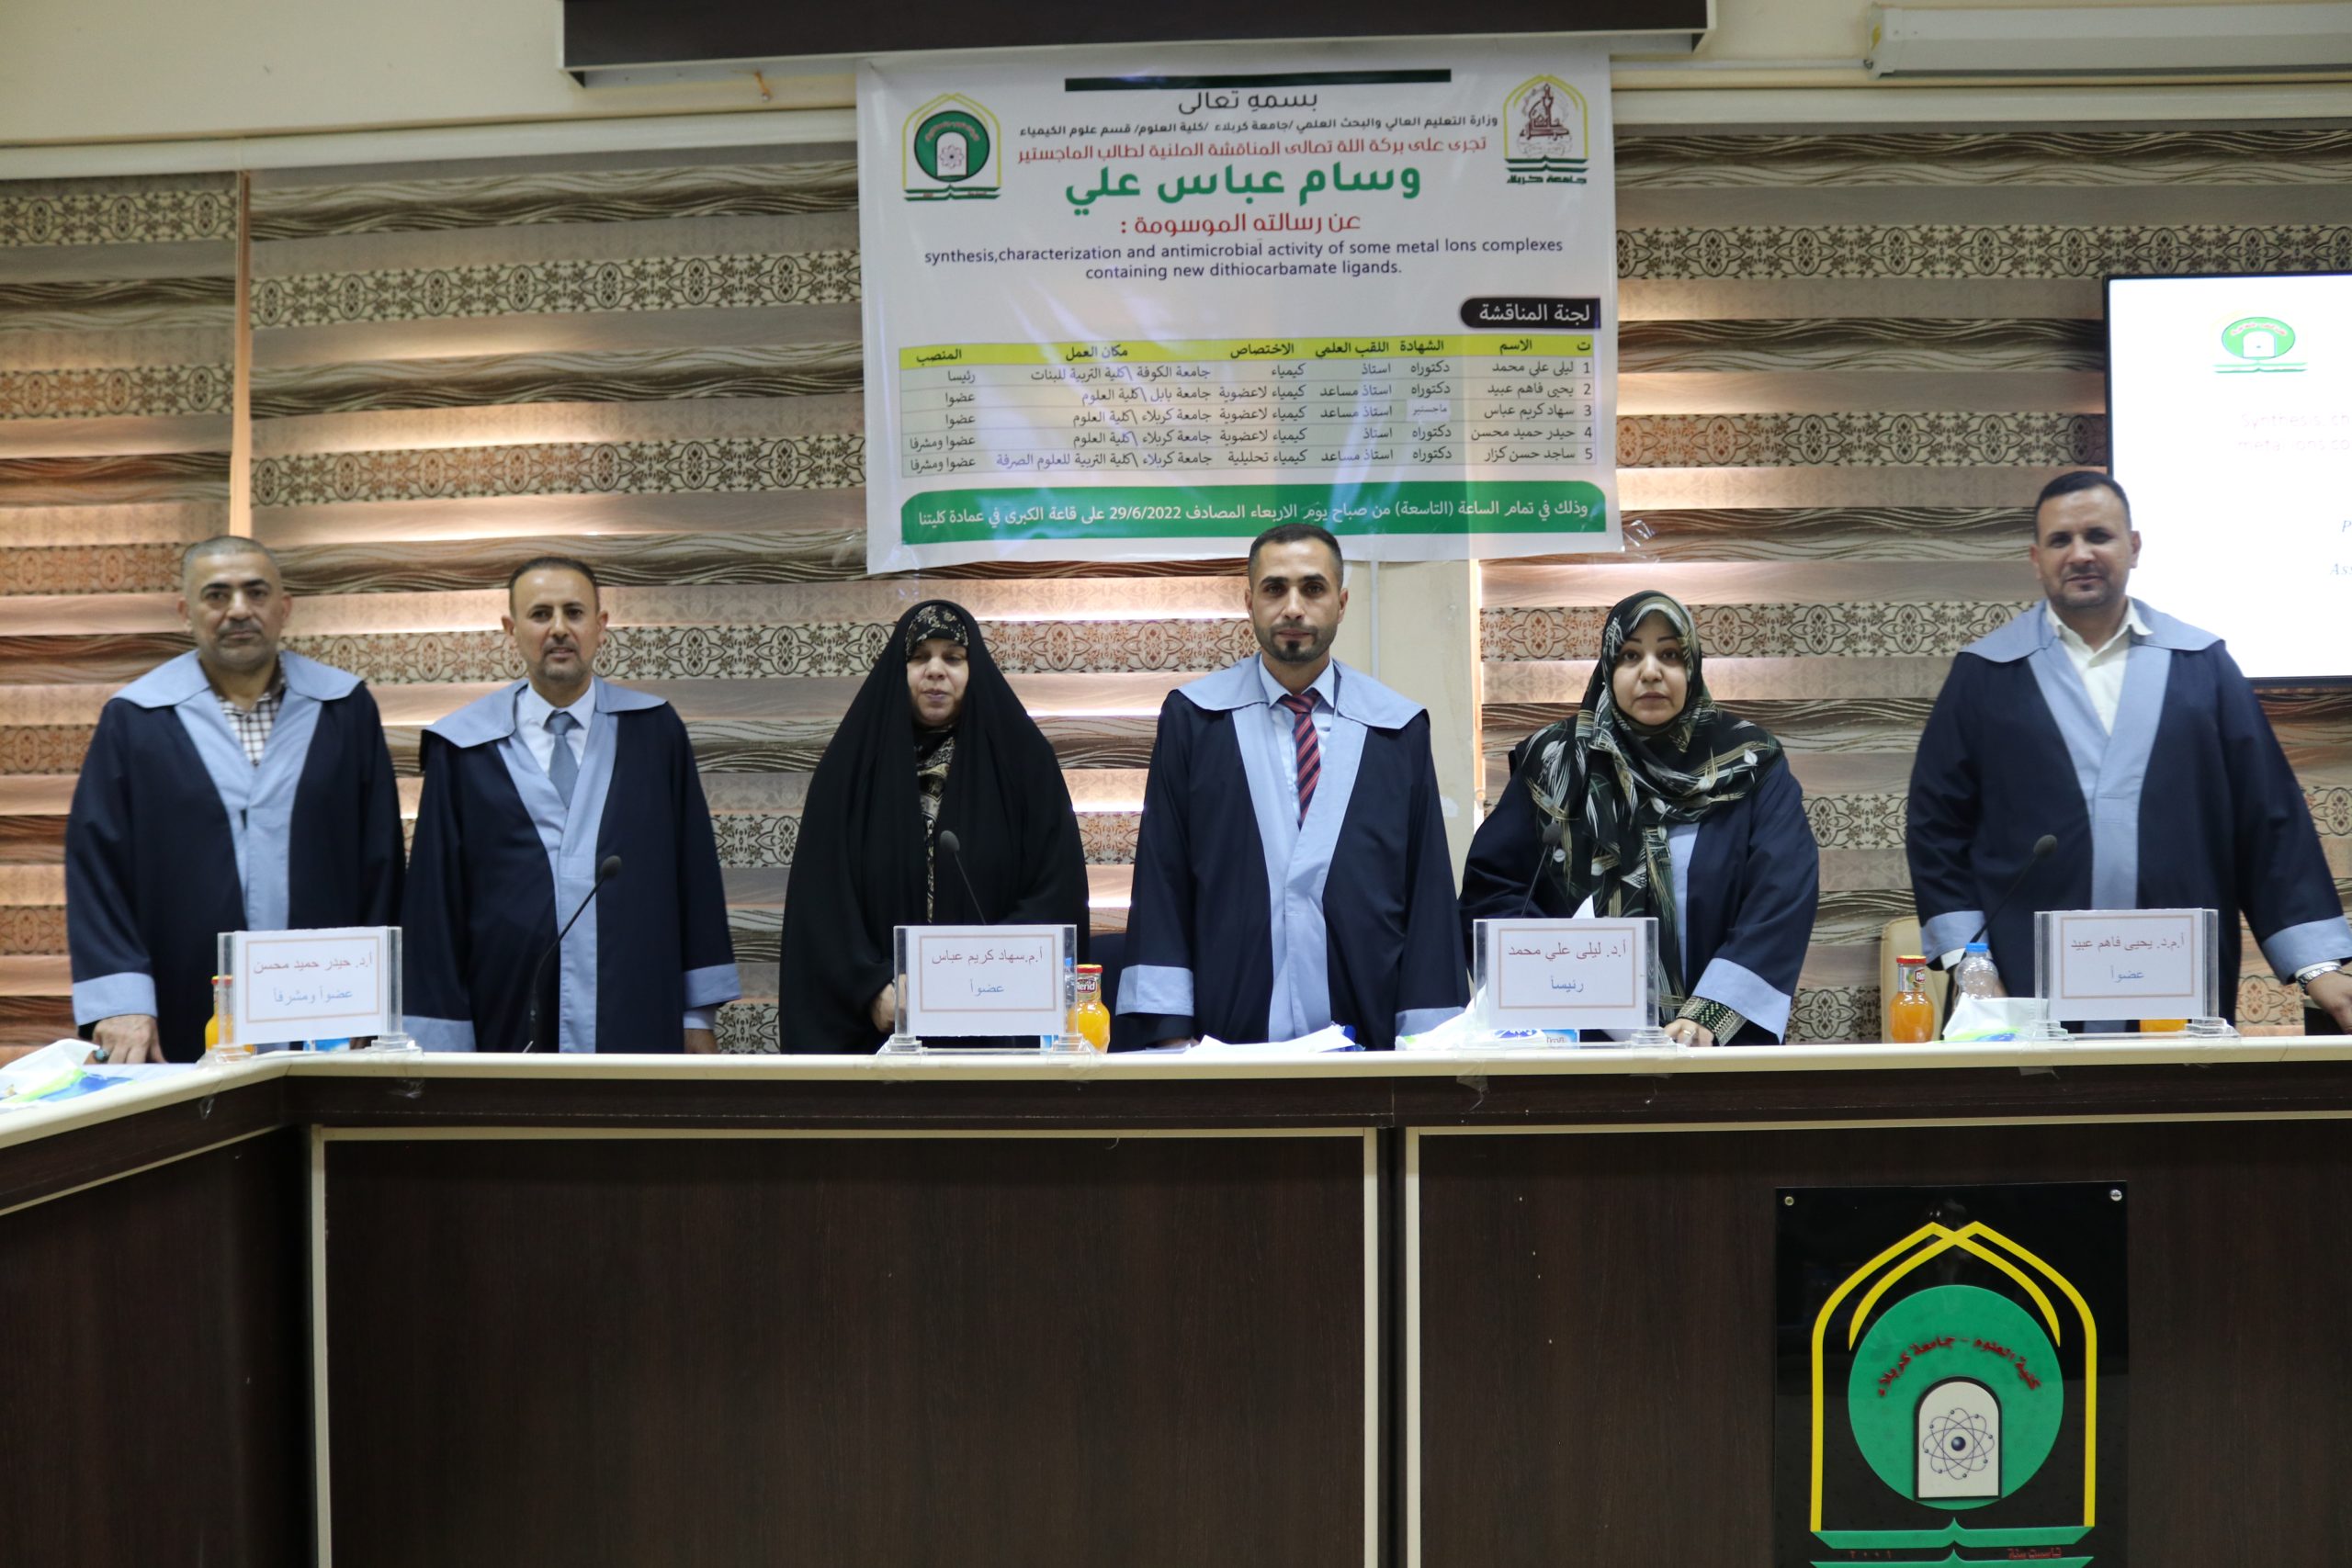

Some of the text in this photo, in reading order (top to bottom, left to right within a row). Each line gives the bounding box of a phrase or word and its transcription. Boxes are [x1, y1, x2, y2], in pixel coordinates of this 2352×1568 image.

[1179, 90, 1238, 115] تعالى
[1215, 121, 1248, 132] كربلاء
[1296, 119, 1336, 134] العلمي
[1340, 118, 1381, 130] والبحث
[1385, 118, 1420, 131] العالي
[1424, 116, 1465, 129] التعليم
[1470, 115, 1498, 128] وزارة
[1020, 125, 1066, 136] الكيمياء
[1069, 125, 1097, 137] علوم
[1101, 124, 1130, 137] قسم
[1149, 142, 1204, 159] العلنية
[1208, 141, 1280, 157] المناقشة
[1285, 140, 1332, 155] تعالى
[1369, 137, 1404, 155] بركة
[1408, 138, 1443, 152] على
[1448, 137, 1487, 154] تجرى
[1018, 145, 1092, 164] الماجستير
[1098, 144, 1144, 162] لطالب
[1066, 162, 1420, 216] وسام عباس علي
[1135, 212, 1360, 237] عن رسالته الموسومة
[1126, 244, 1155, 258] and
[1161, 242, 1262, 257] antimicrobial
[1268, 242, 1323, 257] activity
[1329, 241, 1344, 254] of
[1350, 243, 1390, 254] some
[1396, 239, 1439, 254] metal
[1482, 238, 1563, 254] complexes
[1086, 260, 1402, 280] containing new dithiocarbamate ligands.
[1479, 303, 1590, 326] لجنة المناقشة
[916, 339, 1590, 363] ت الاسم الشهادة اللقب العلمي الاختصاص مكان العمل المنصب
[1031, 368, 1066, 380] للبنات
[1071, 367, 1101, 382] التربية
[1136, 366, 1171, 381] الكوفة
[1176, 365, 1210, 378] جامعة
[1272, 363, 1306, 378] كيمياء
[1362, 363, 1391, 375] استاذ
[1410, 360, 1450, 377] دكتوراه
[1492, 363, 1524, 373] محمد
[1529, 361, 1549, 377] علي
[1553, 361, 1574, 376] ليلى
[1583, 363, 1590, 374] 1
[947, 370, 976, 383] رئيسا
[1150, 388, 1172, 402] بابل
[1176, 387, 1211, 399] جامعة
[1219, 386, 1267, 402] لاعضوية
[1272, 384, 1306, 400] كيمياء
[1320, 386, 1358, 397] مساعد
[1362, 384, 1392, 396] استاذ
[1410, 381, 1451, 399] دكتوراه
[1487, 384, 1513, 397] عبيد
[1517, 382, 1544, 398] فاهم
[1583, 383, 1591, 395] 2
[945, 391, 976, 407] عضوا
[1081, 389, 1114, 406] العلوم
[1142, 408, 1175, 423] كربلاء
[1320, 407, 1359, 418] مساعد
[1363, 405, 1392, 417] استاذ
[1484, 404, 1515, 419] عباس
[1519, 403, 1544, 420] كريم
[1547, 404, 1574, 419] سهاد
[1583, 404, 1591, 416] 3
[910, 424, 1592, 452] 4 حيدر حميد محسن دكتوراه عضوا ومشرفا
[996, 446, 1592, 469] 5 ساجد حسن كزار تحليلية للعلوم الصرفة
[919, 501, 1589, 528] وذلك في تمام الساعة (التاسعة) من صباح يوم الاربعاء المصادف 29/6/2022 على قاعة الكبرى في عمادة كليتنا
[1508, 946, 1542, 956] محمد
[1545, 942, 1570, 962] علي
[1576, 942, 1601, 960] ليلى
[2071, 940, 2093, 951] عبيد
[2098, 936, 2121, 953] فاهم
[932, 949, 963, 964] عباس
[967, 948, 994, 965] كريم
[254, 962, 289, 975] محسن
[294, 960, 320, 972] حميد
[325, 958, 351, 971] حيدر
